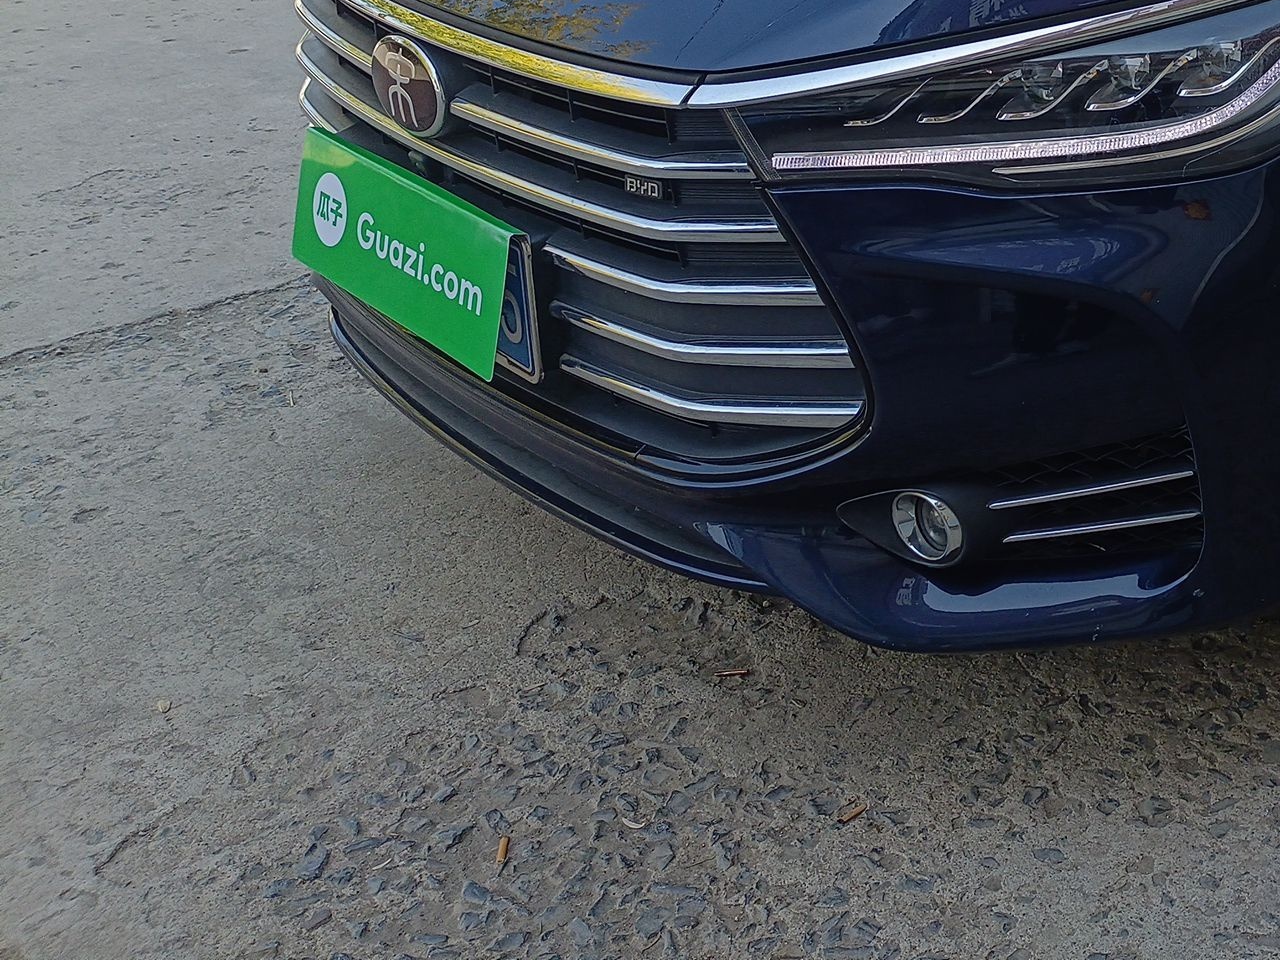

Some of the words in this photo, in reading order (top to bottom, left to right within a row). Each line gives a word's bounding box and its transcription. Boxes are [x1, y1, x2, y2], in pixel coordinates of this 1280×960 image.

[626, 177, 659, 198] BYD
[316, 190, 344, 228] 瓜子
[356, 211, 483, 317] Guazi.com
